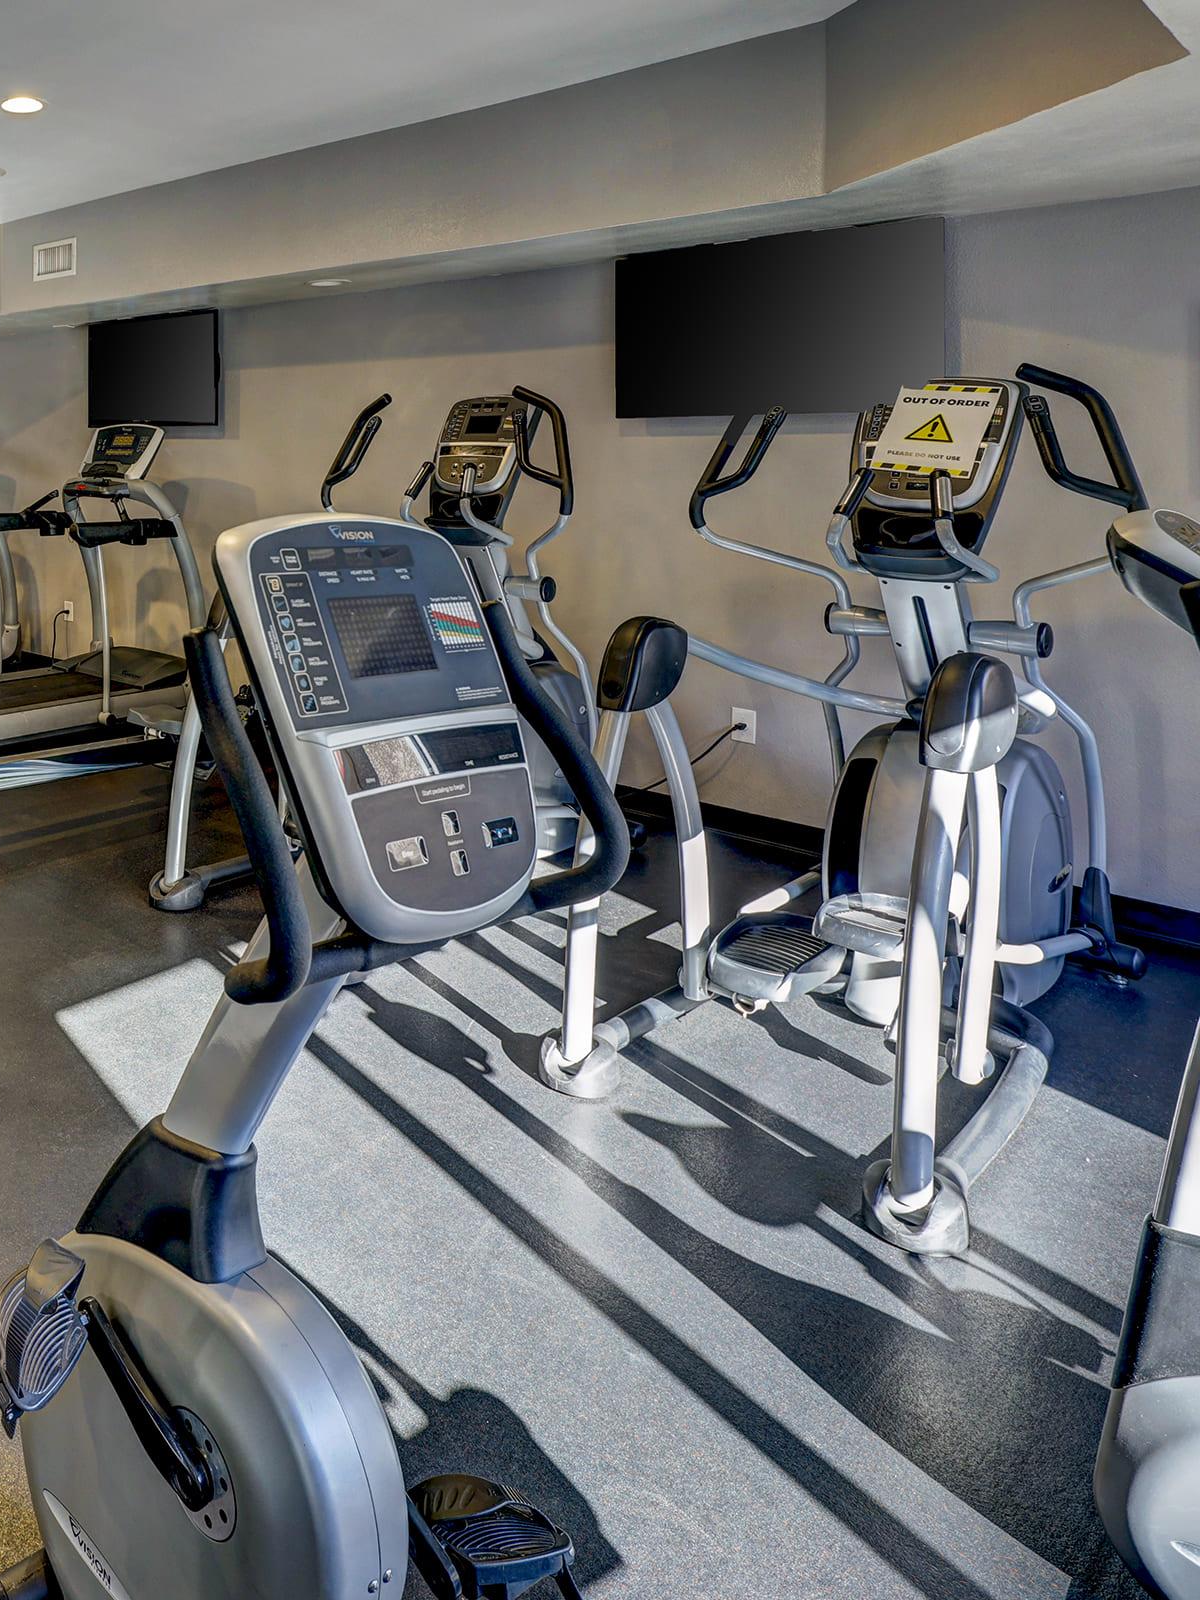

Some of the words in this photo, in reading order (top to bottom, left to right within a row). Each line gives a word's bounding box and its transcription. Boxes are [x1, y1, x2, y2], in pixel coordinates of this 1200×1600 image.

[903, 397, 928, 405] OUT
[947, 398, 990, 408] ORDER
[340, 531, 374, 540] VISION
[421, 789, 432, 797] Start
[432, 786, 449, 796] pedaling
[454, 784, 466, 792] begin
[77, 1535, 112, 1585] VISION
